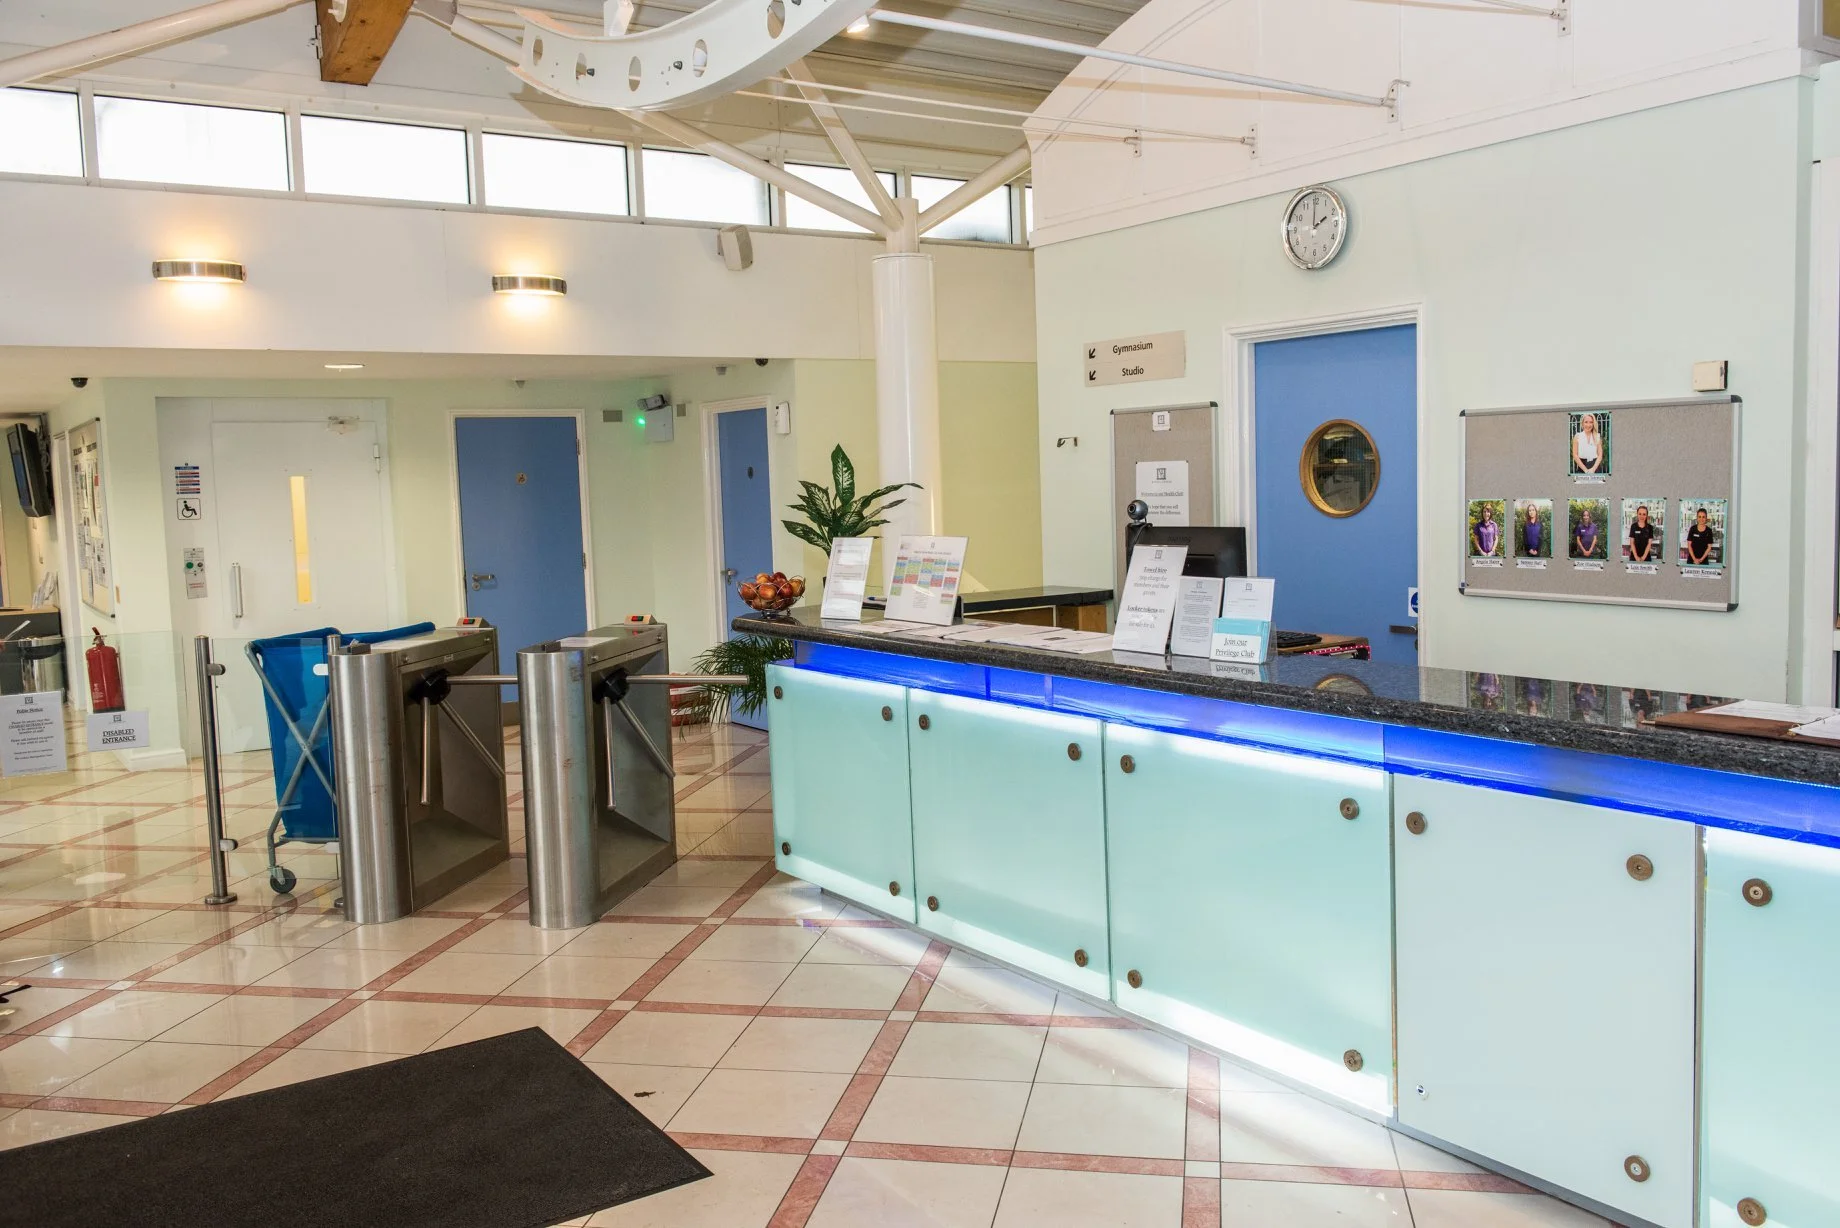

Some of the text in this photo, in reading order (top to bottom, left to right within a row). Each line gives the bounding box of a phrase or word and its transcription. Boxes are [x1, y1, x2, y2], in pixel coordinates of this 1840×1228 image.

[1331, 208, 1336, 216] 2
[1296, 214, 1303, 222] 10
[1333, 220, 1338, 228] 3
[1293, 226, 1298, 234] 9
[1330, 233, 1335, 241] 4
[1303, 246, 1308, 254] 7
[1322, 244, 1328, 252] 5
[1312, 248, 1317, 257] 6
[1112, 341, 1154, 356] Gymnasium
[1121, 365, 1145, 377] Studio
[1127, 605, 1143, 613] Locker
[1223, 637, 1236, 647] Join
[1215, 648, 1255, 659] Privilege Club
[102, 729, 135, 737] DISABLED
[102, 735, 136, 744] ENTRANCE
